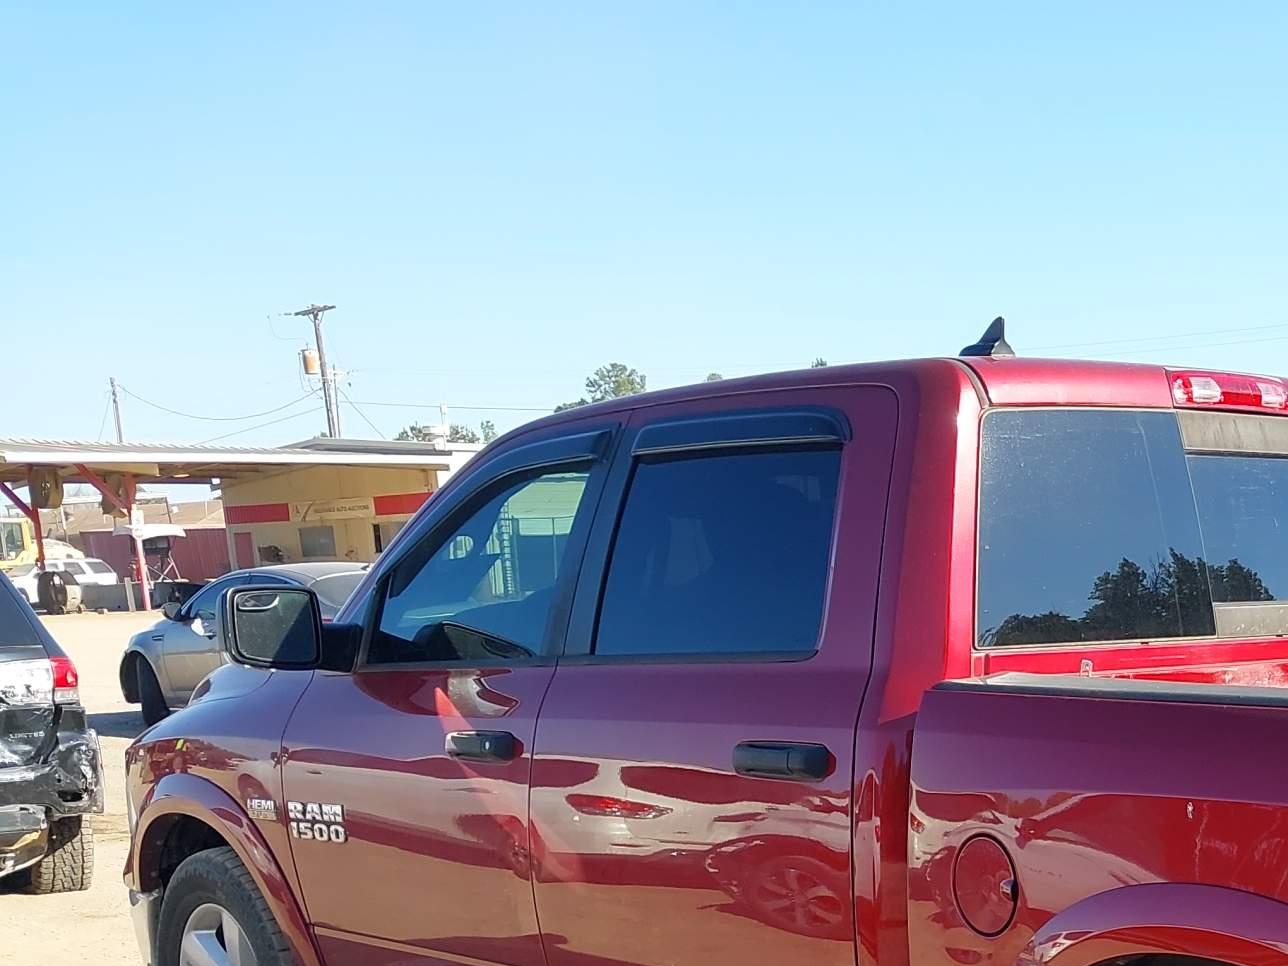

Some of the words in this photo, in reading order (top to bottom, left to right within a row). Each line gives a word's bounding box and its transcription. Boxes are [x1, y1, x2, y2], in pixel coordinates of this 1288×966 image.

[247, 798, 275, 811] HEMI
[288, 801, 345, 823] RAM
[290, 821, 347, 844] 1500
